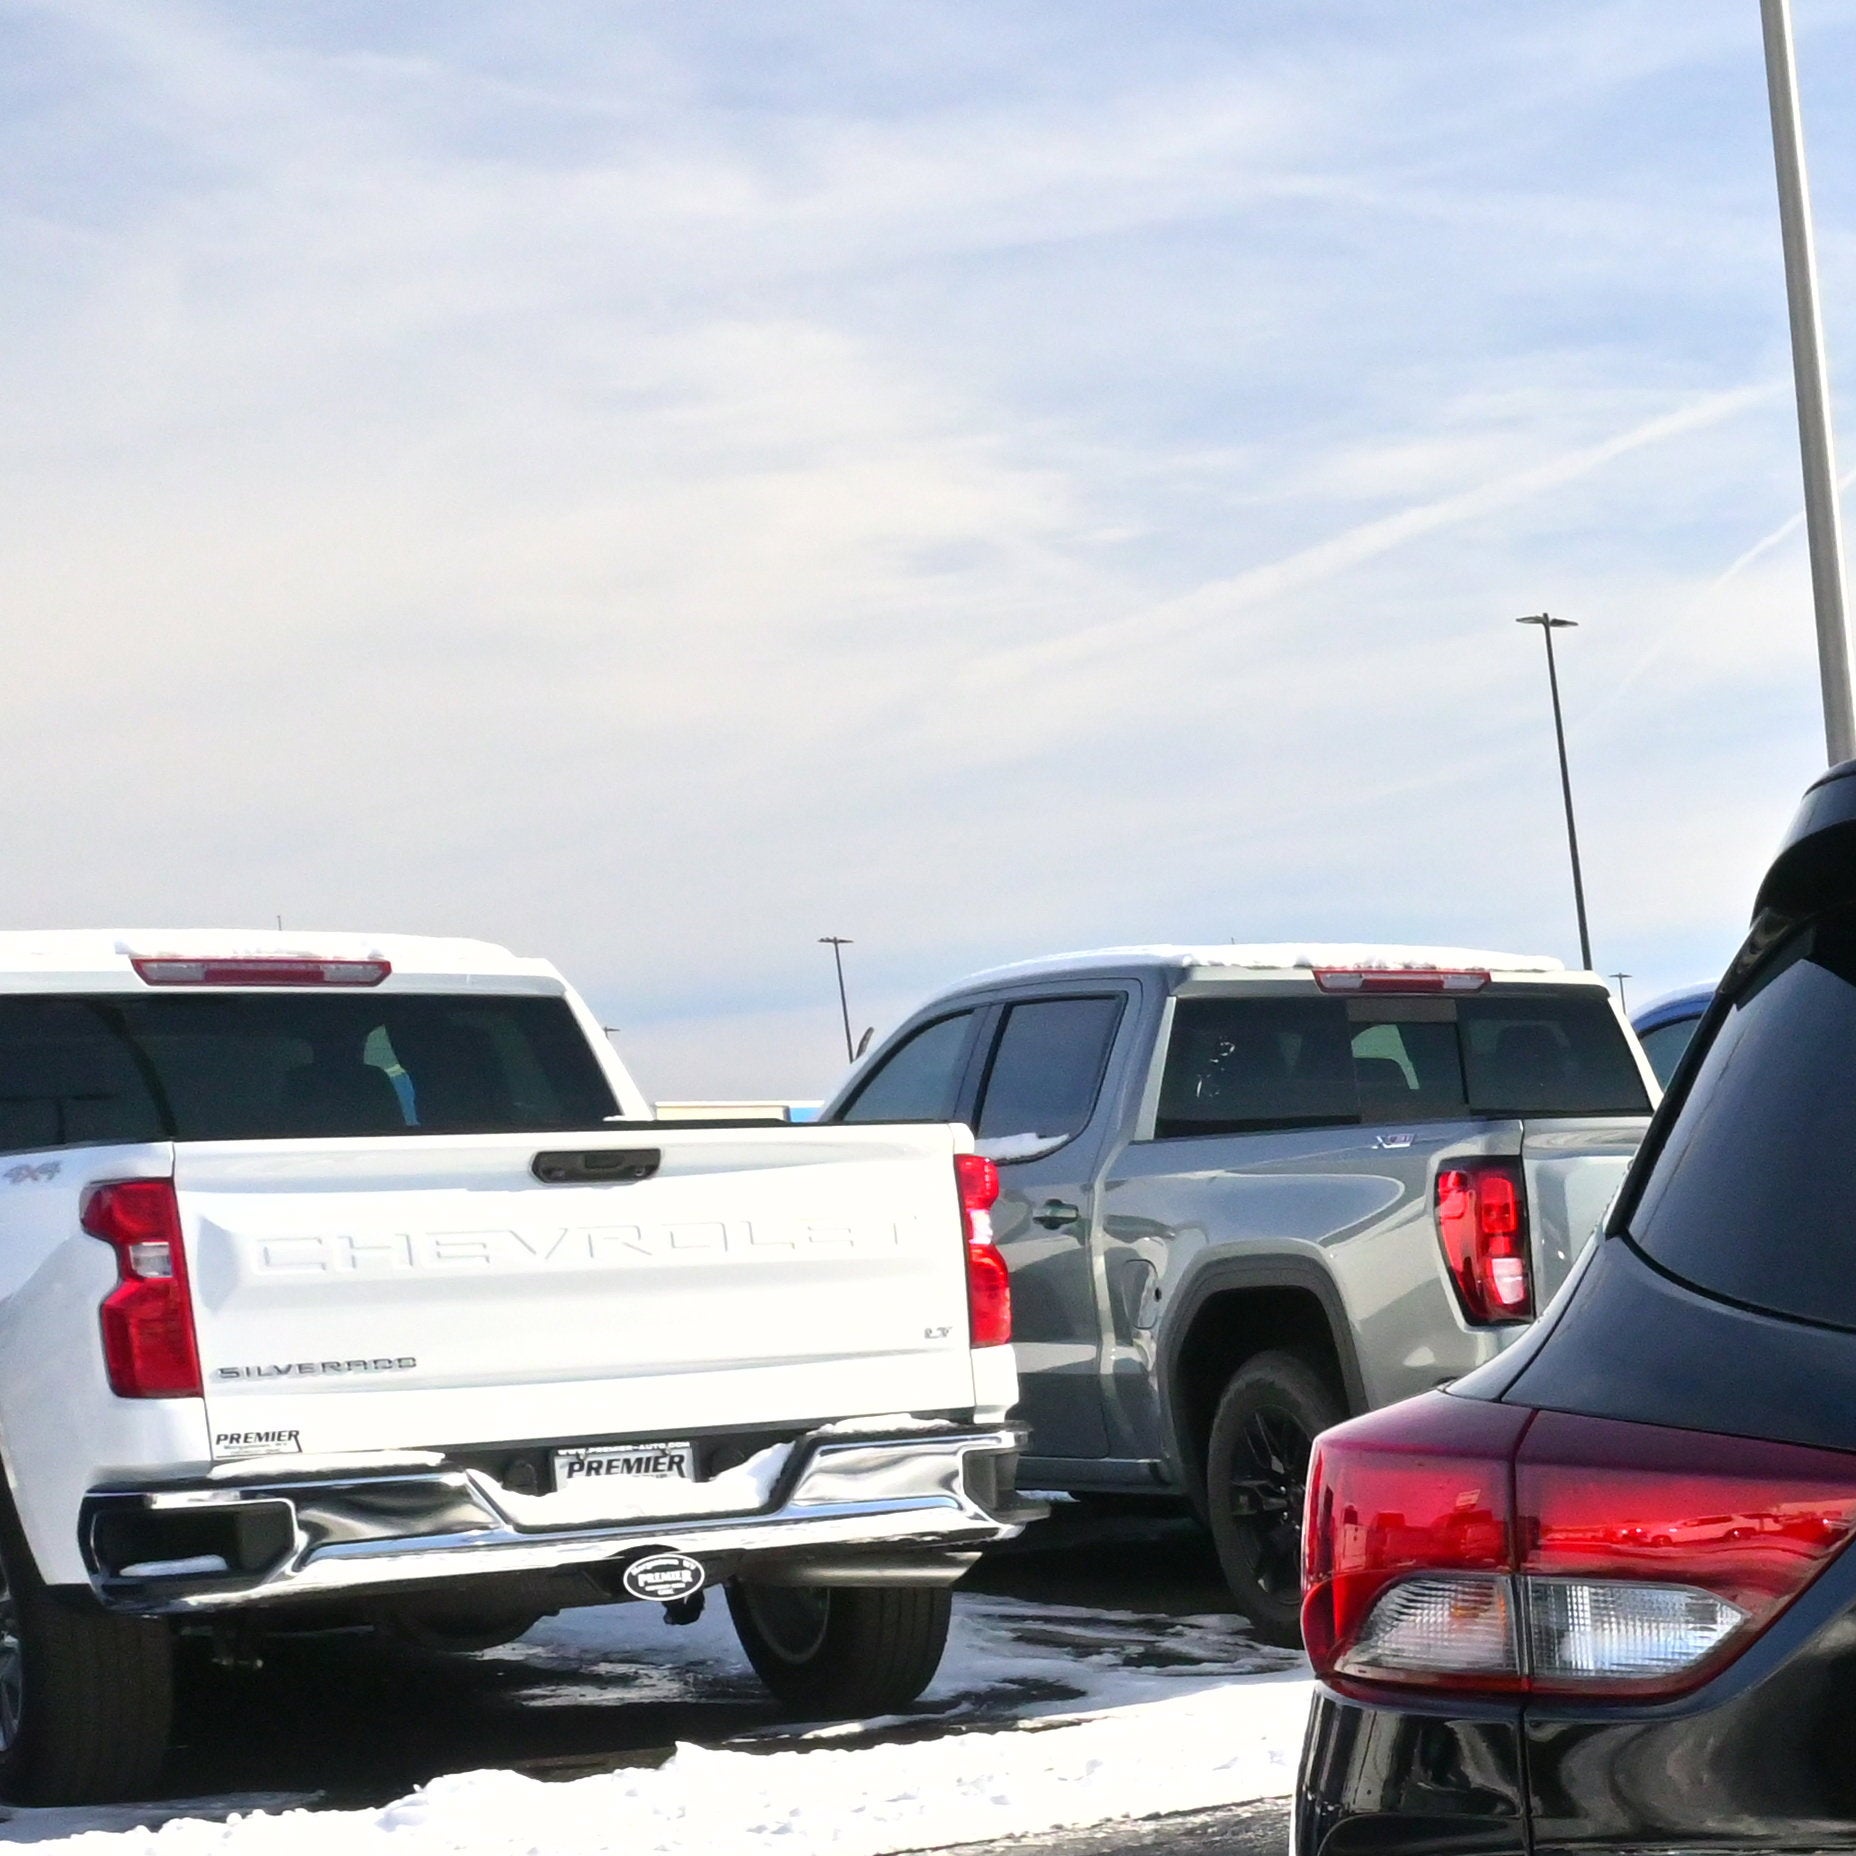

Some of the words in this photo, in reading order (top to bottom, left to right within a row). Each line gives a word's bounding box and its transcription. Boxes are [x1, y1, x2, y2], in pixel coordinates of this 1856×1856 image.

[218, 1356, 418, 1380] SILVERADO
[215, 1429, 301, 1447] PREMIER
[567, 1454, 686, 1479] PREMIER
